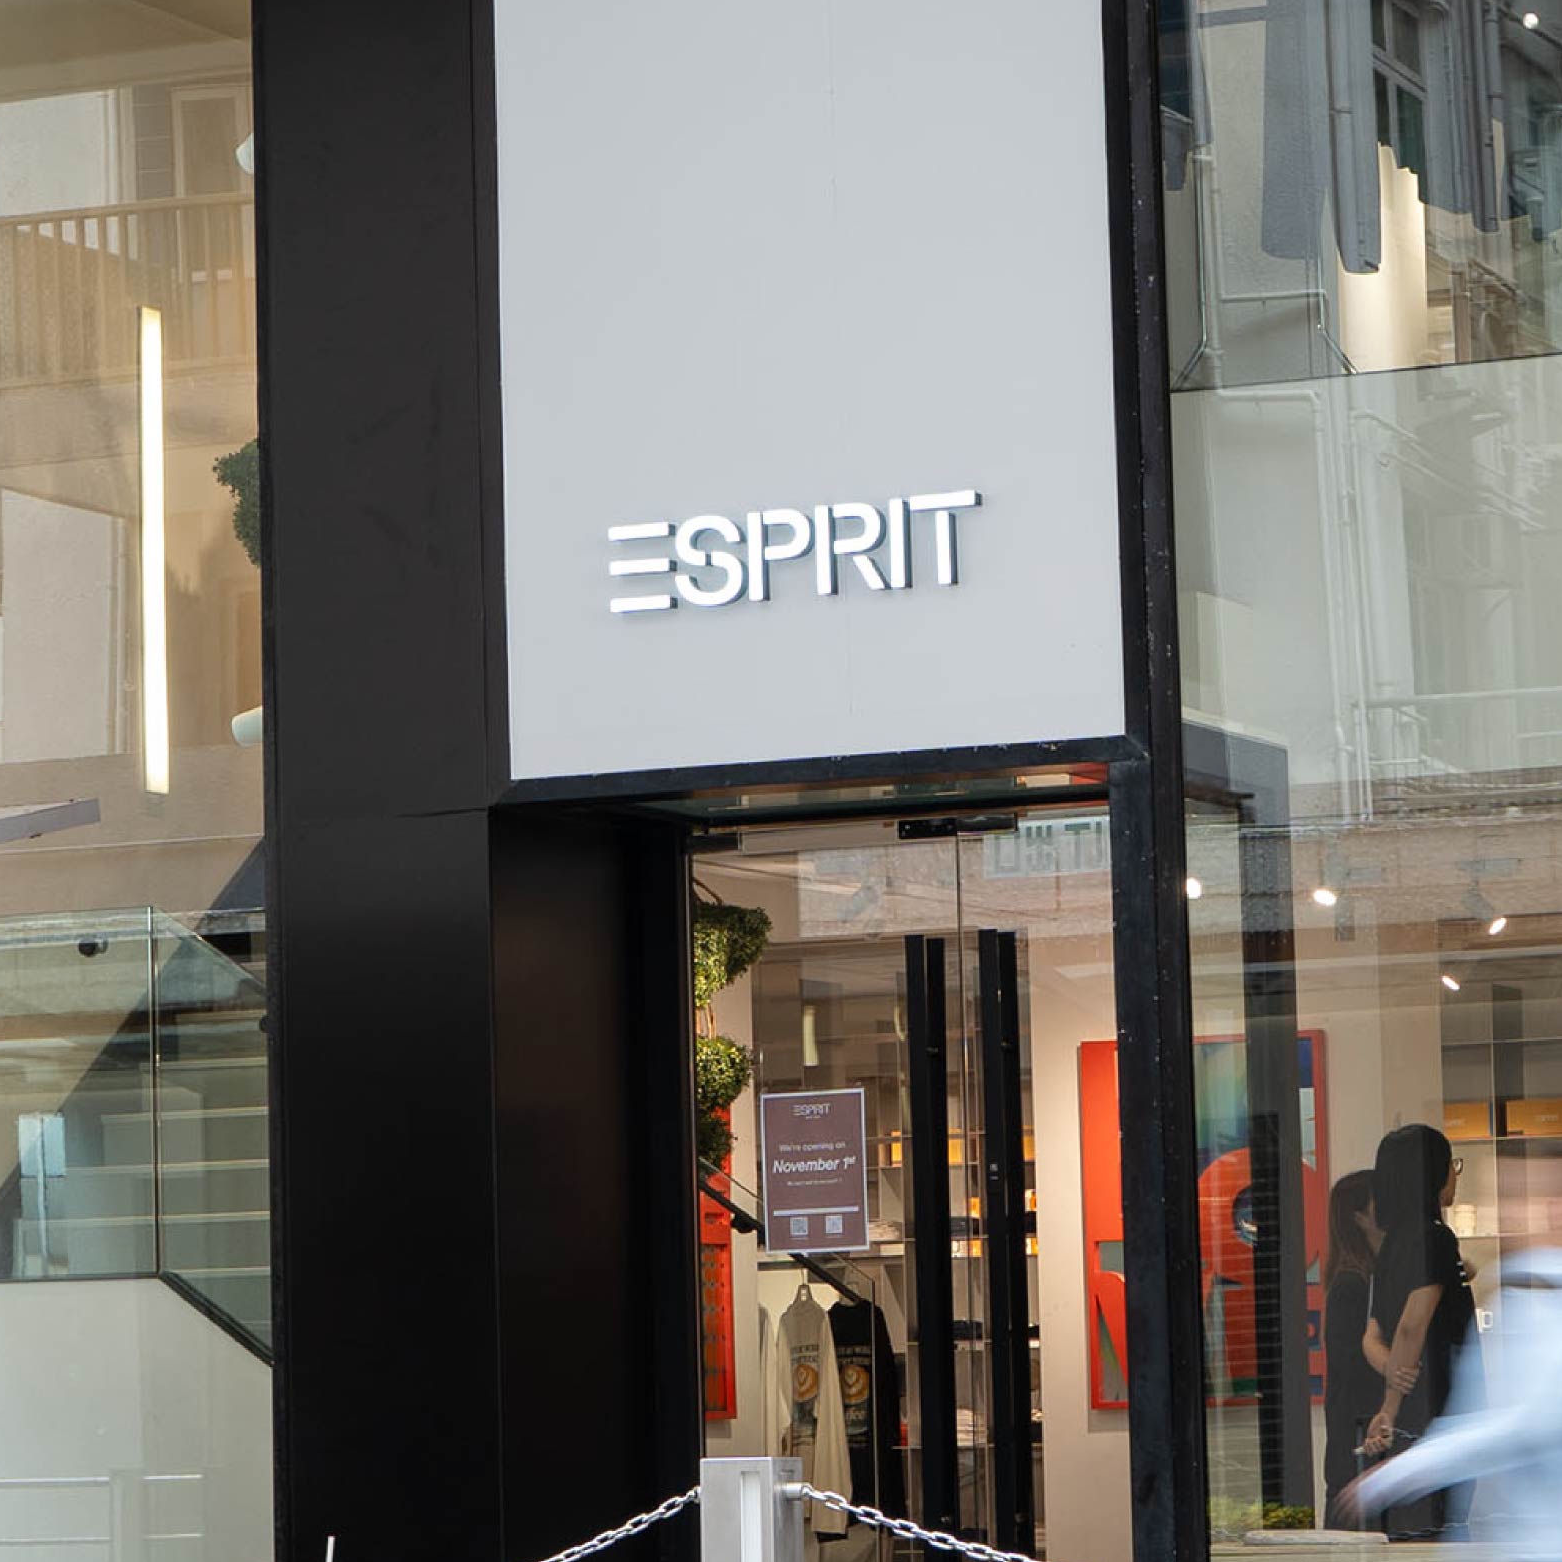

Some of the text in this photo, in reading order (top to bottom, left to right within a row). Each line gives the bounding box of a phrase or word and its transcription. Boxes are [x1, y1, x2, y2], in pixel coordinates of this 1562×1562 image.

[608, 489, 982, 613] ESPRIT
[792, 1103, 830, 1115] ESPRIT
[773, 1157, 839, 1173] November
